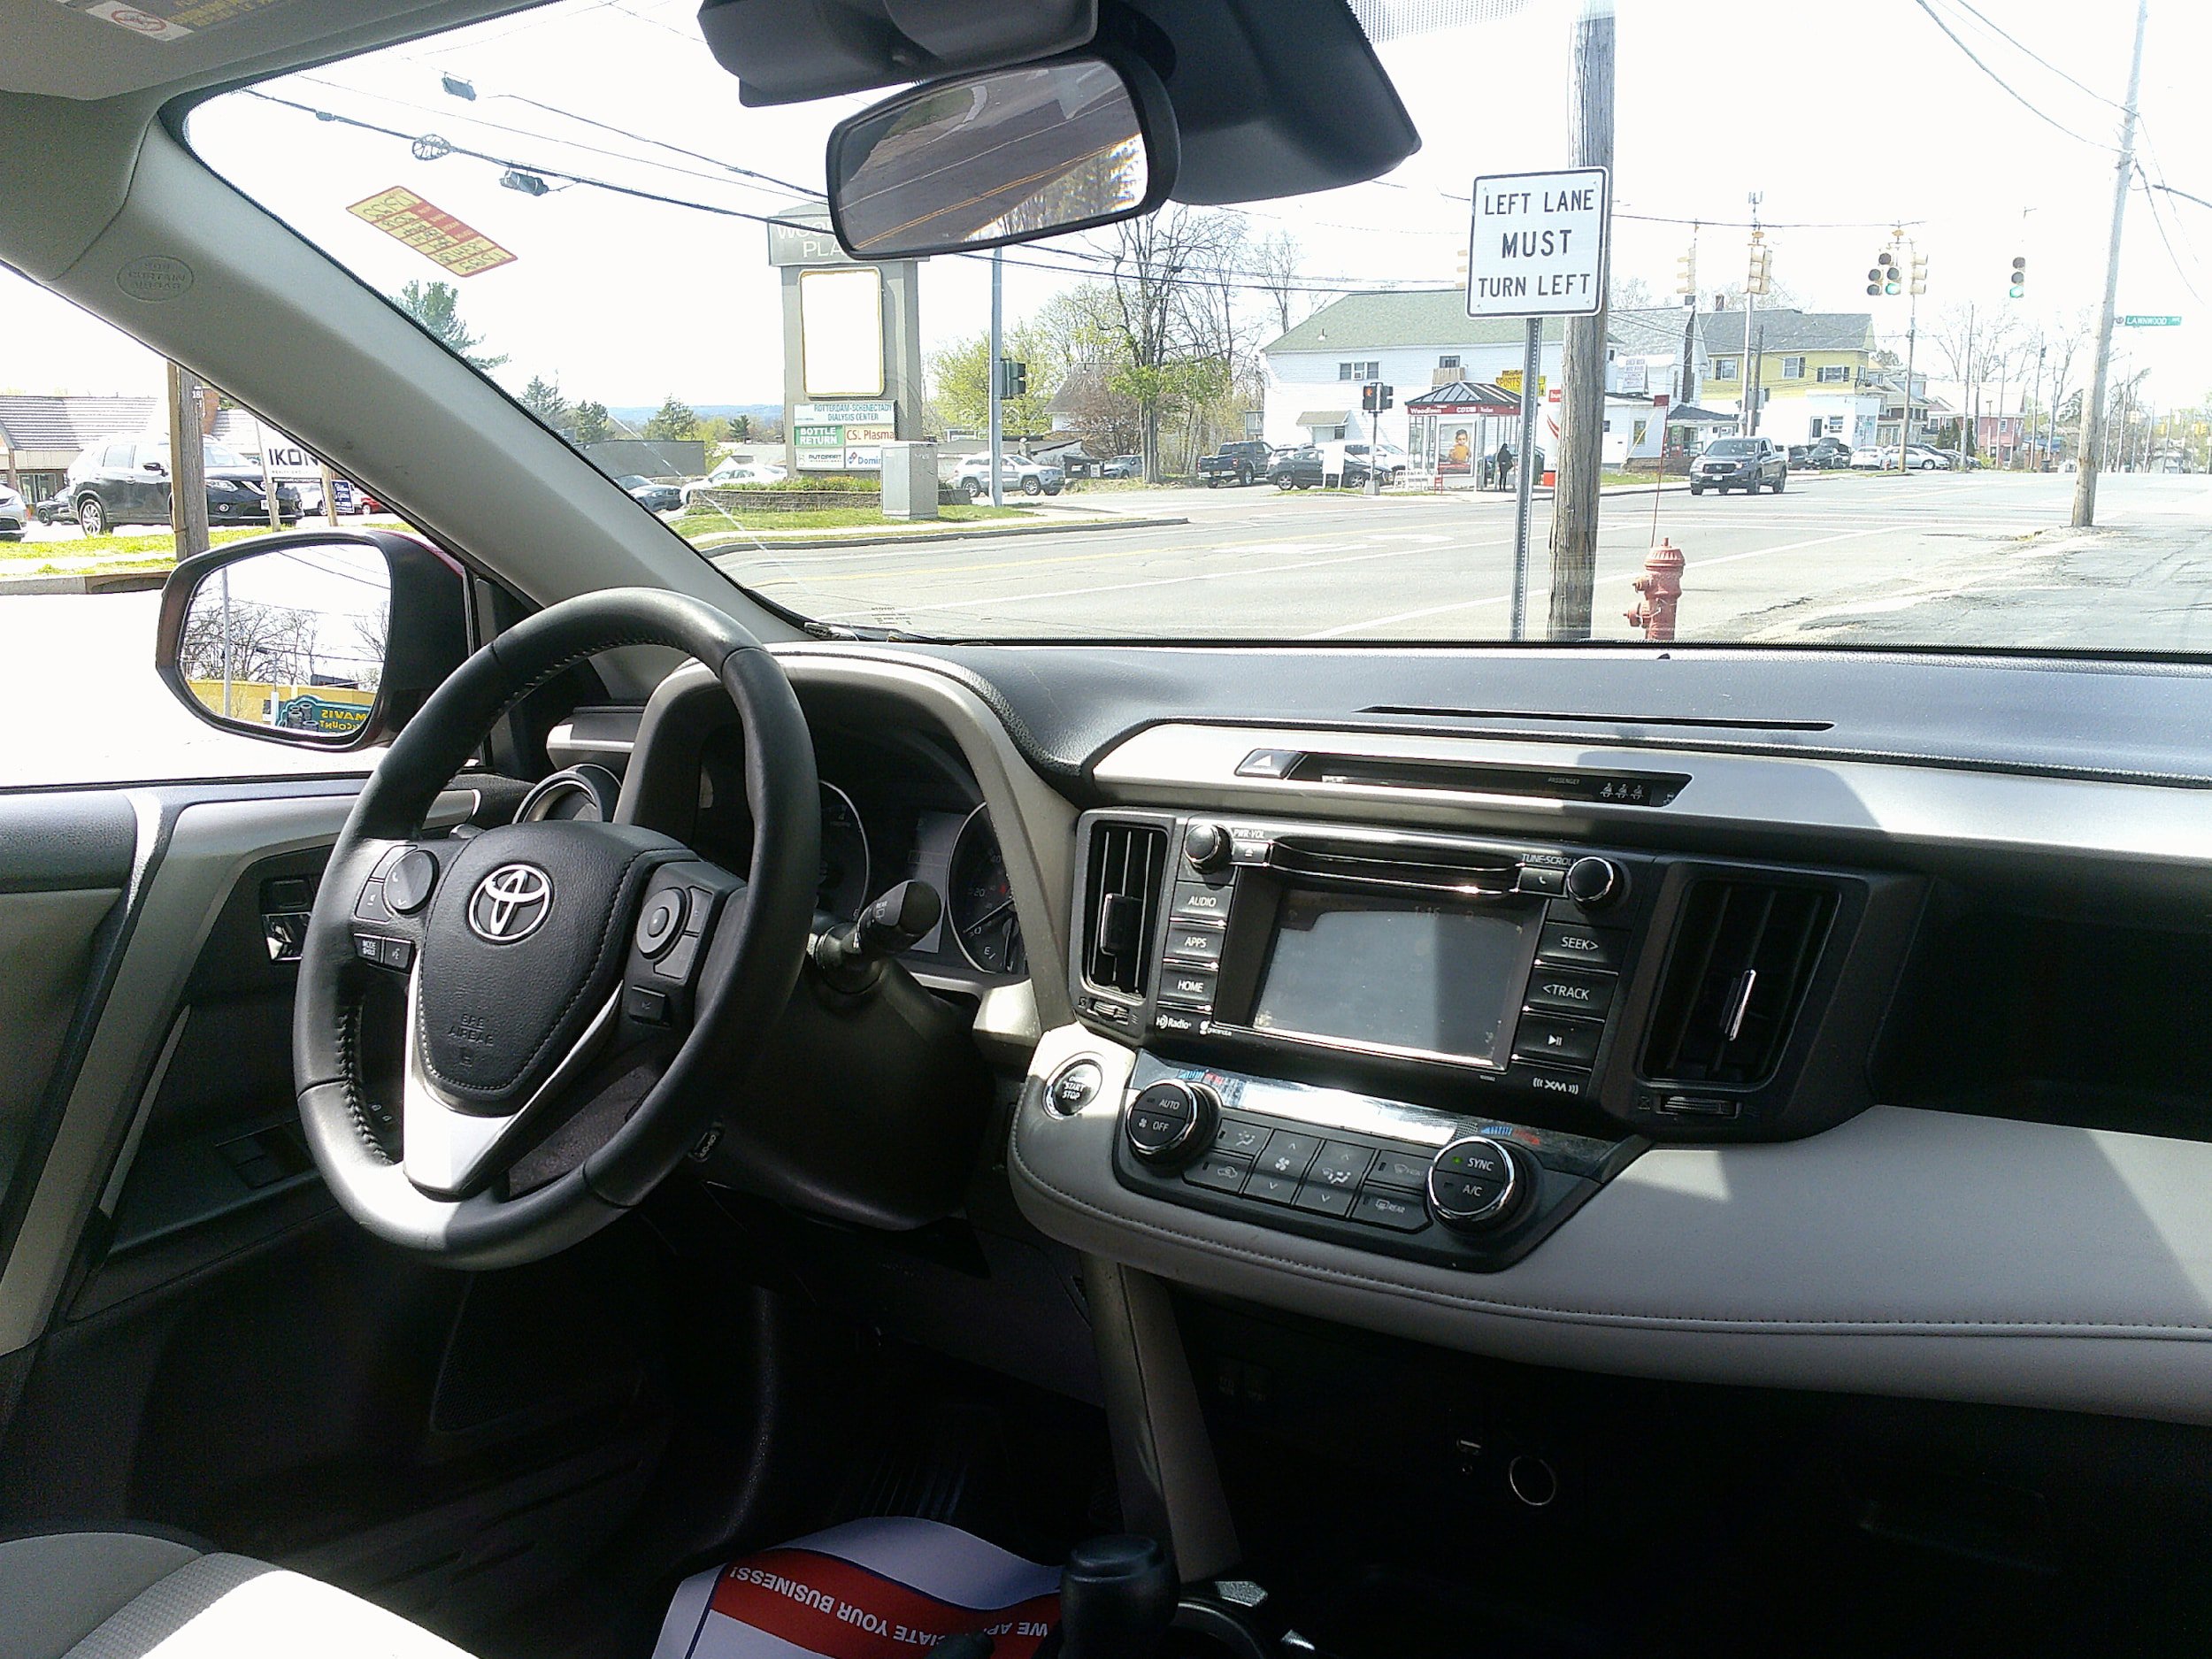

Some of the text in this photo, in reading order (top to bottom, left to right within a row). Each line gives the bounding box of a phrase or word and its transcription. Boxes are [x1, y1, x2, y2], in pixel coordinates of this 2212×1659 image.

[1485, 189, 1594, 215] LEFT LANE
[803, 241, 842, 258] PLA
[1502, 229, 1572, 258] MUST
[1479, 273, 1590, 297] TURN LEFT
[814, 403, 892, 412] ROTTERDAM-SCHENECTADY
[864, 430, 895, 441] Plasma
[269, 449, 319, 466] IKON
[1188, 896, 1217, 907] AUDIO
[1185, 937, 1207, 949] APPS
[1178, 979, 1204, 993] HOME
[1063, 1090, 1080, 1100] STOP
[1159, 1099, 1179, 1110] AUTO
[1153, 1121, 1170, 1132] OFF
[1468, 1157, 1494, 1171] SYNC
[1463, 1185, 1482, 1196] A/C
[1388, 1203, 1405, 1213] REAR
[730, 1566, 835, 1614] BUSINESS!
[836, 1602, 888, 1636] YOUR
[1018, 1622, 1048, 1636] WE
